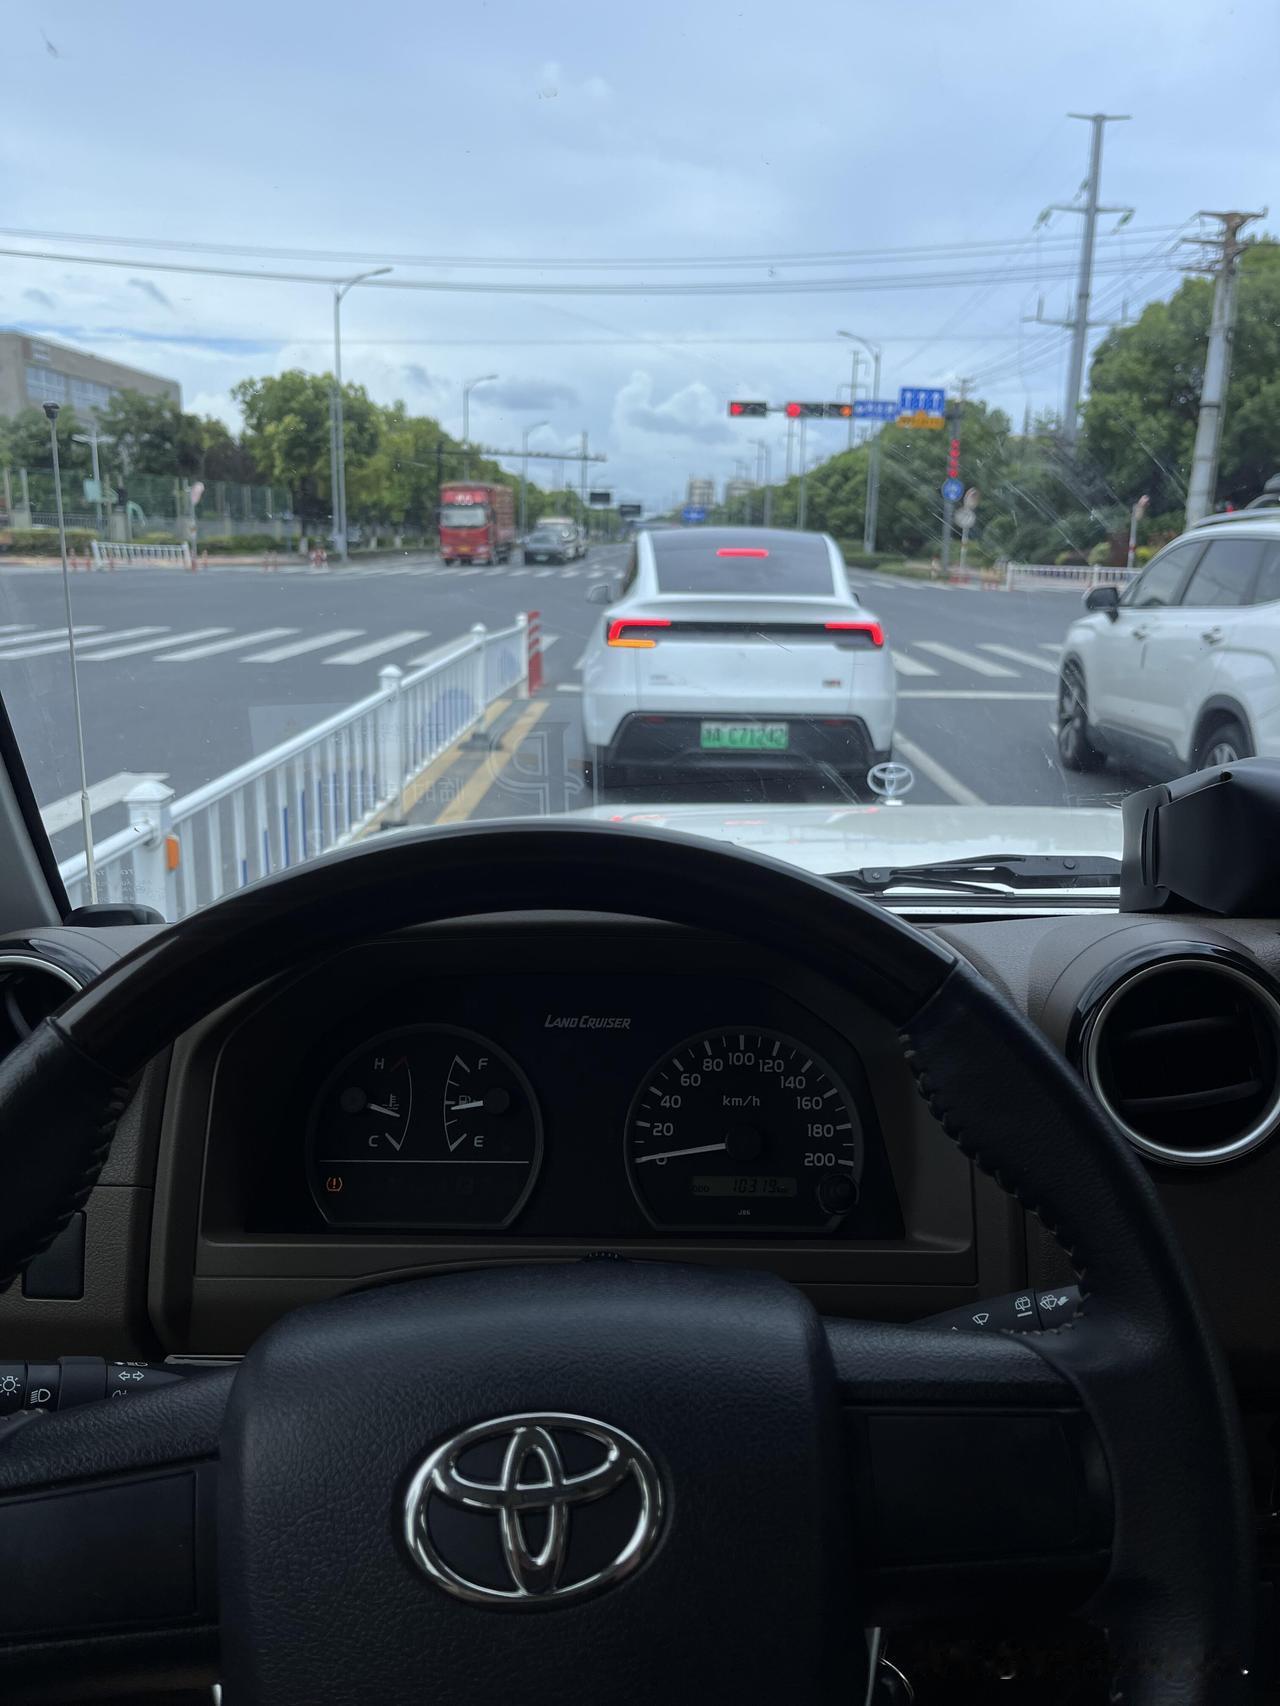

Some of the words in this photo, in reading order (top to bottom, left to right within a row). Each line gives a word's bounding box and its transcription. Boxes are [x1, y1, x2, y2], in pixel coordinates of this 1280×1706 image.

[544, 1014, 579, 1029] LAND
[578, 1015, 632, 1030] CRUISER
[373, 1057, 385, 1070] H
[477, 1057, 489, 1070] F
[702, 1058, 724, 1072] 80
[728, 1052, 755, 1066] 100
[759, 1059, 785, 1073] 120
[680, 1073, 702, 1087] 60
[780, 1075, 807, 1089] 140
[660, 1095, 682, 1109] 40
[722, 1095, 761, 1107] km/h
[797, 1096, 823, 1110] 160
[652, 1122, 674, 1137] 20
[807, 1123, 834, 1138] 180
[368, 1135, 379, 1148] C
[473, 1135, 485, 1148] E
[804, 1152, 836, 1167] 200
